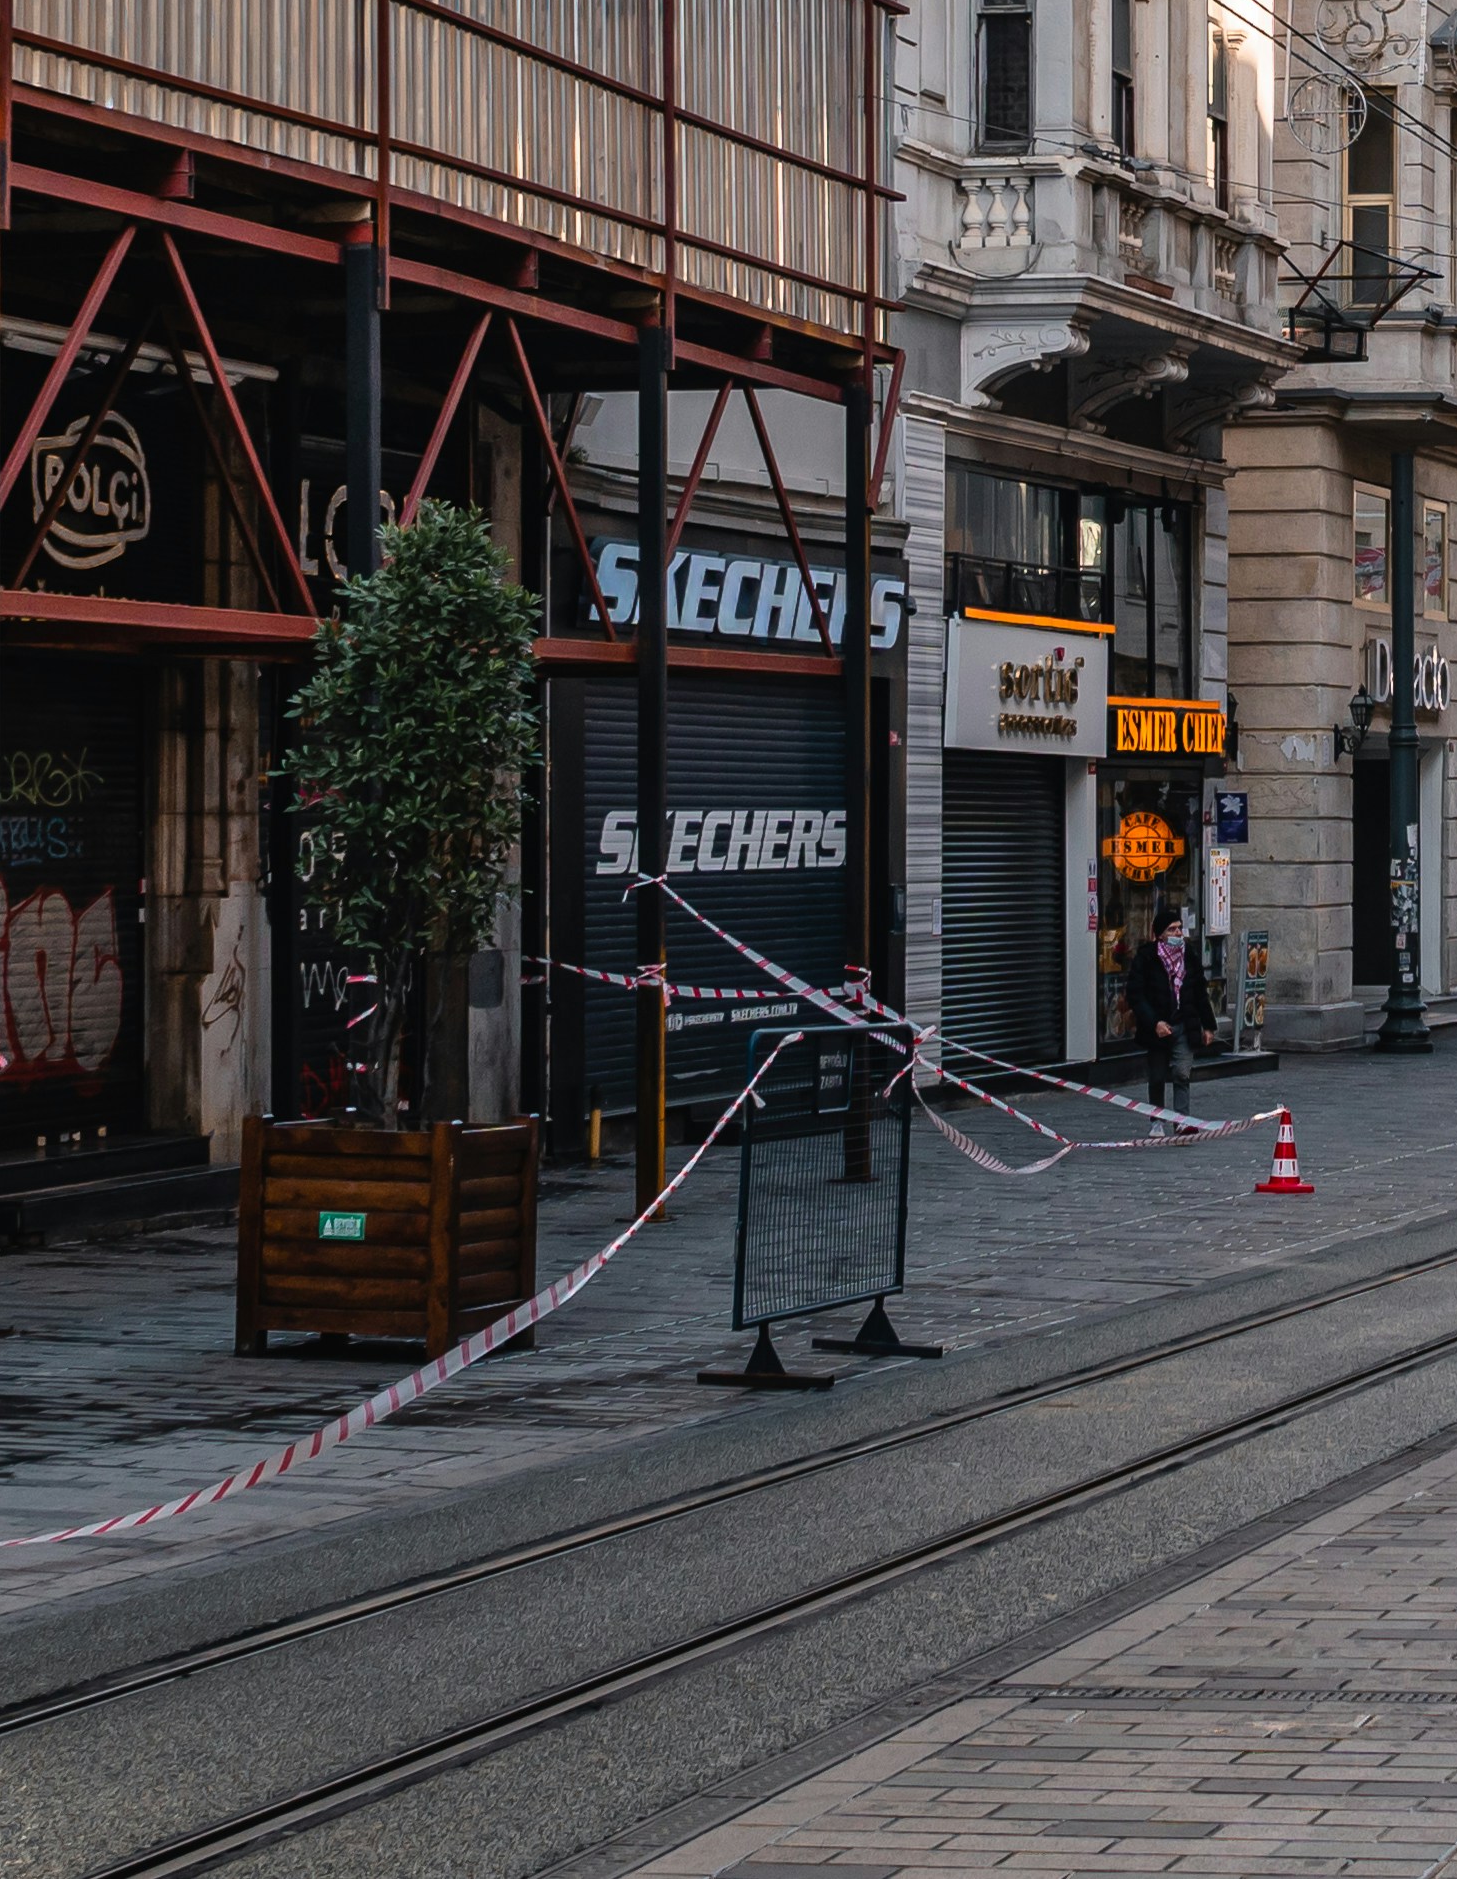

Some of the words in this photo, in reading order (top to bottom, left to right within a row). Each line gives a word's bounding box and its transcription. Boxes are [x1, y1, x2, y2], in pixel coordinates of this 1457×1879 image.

[1374, 638, 1451, 711] Dacto
[1116, 709, 1178, 752] ESMER
[1182, 712, 1226, 754] CHEF
[596, 810, 848, 875] SECHERS
[1110, 840, 1177, 855] ESMER
